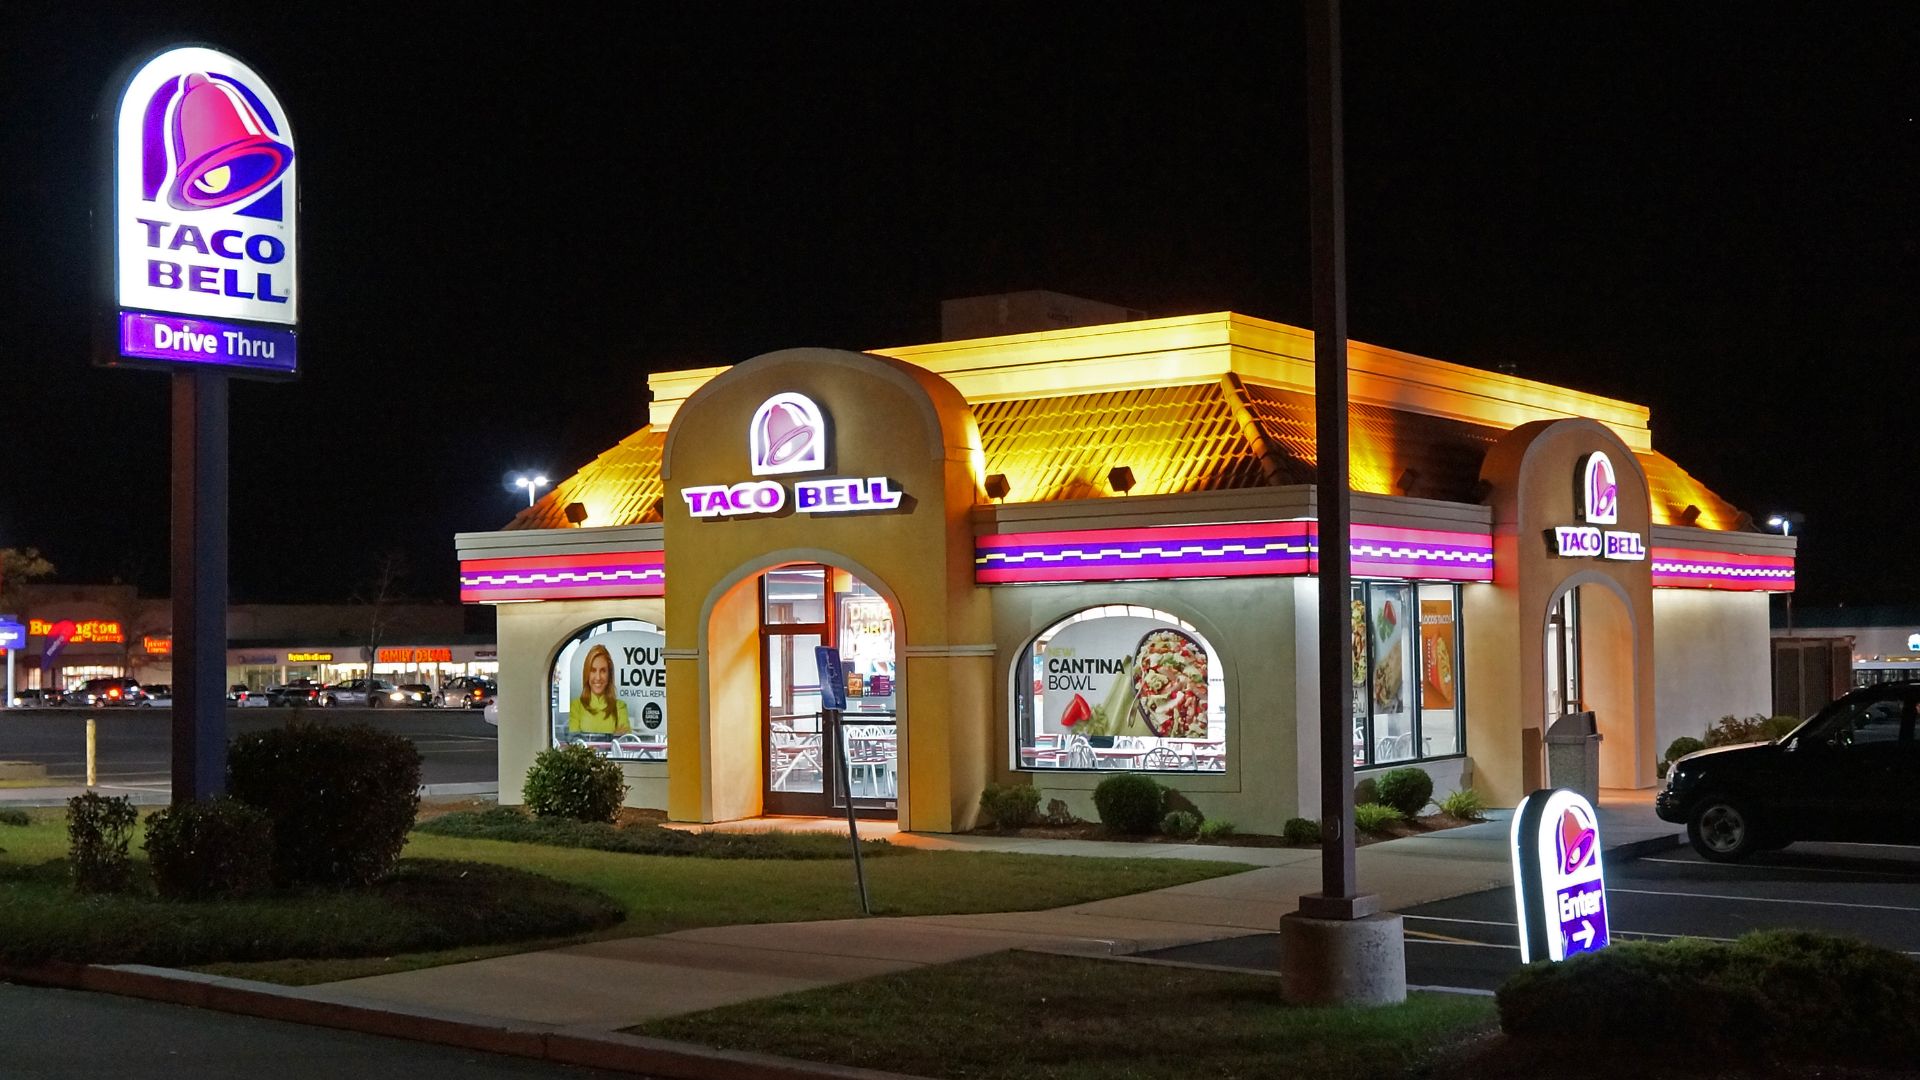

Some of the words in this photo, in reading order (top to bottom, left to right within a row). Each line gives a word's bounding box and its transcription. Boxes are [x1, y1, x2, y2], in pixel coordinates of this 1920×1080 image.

[136, 217, 286, 264] TACO
[148, 259, 289, 304] BELL
[154, 323, 218, 354] Drive
[222, 331, 275, 359] Thru
[686, 486, 780, 513] TACO
[798, 482, 895, 509] BELL
[1560, 532, 1601, 552] TACO
[1607, 535, 1644, 555] BELL
[620, 668, 666, 687] LOVE
[1048, 658, 1125, 675] CANTINA
[620, 689, 629, 697] OR
[1048, 675, 1097, 691] BOWL
[1558, 888, 1603, 923] Enter
